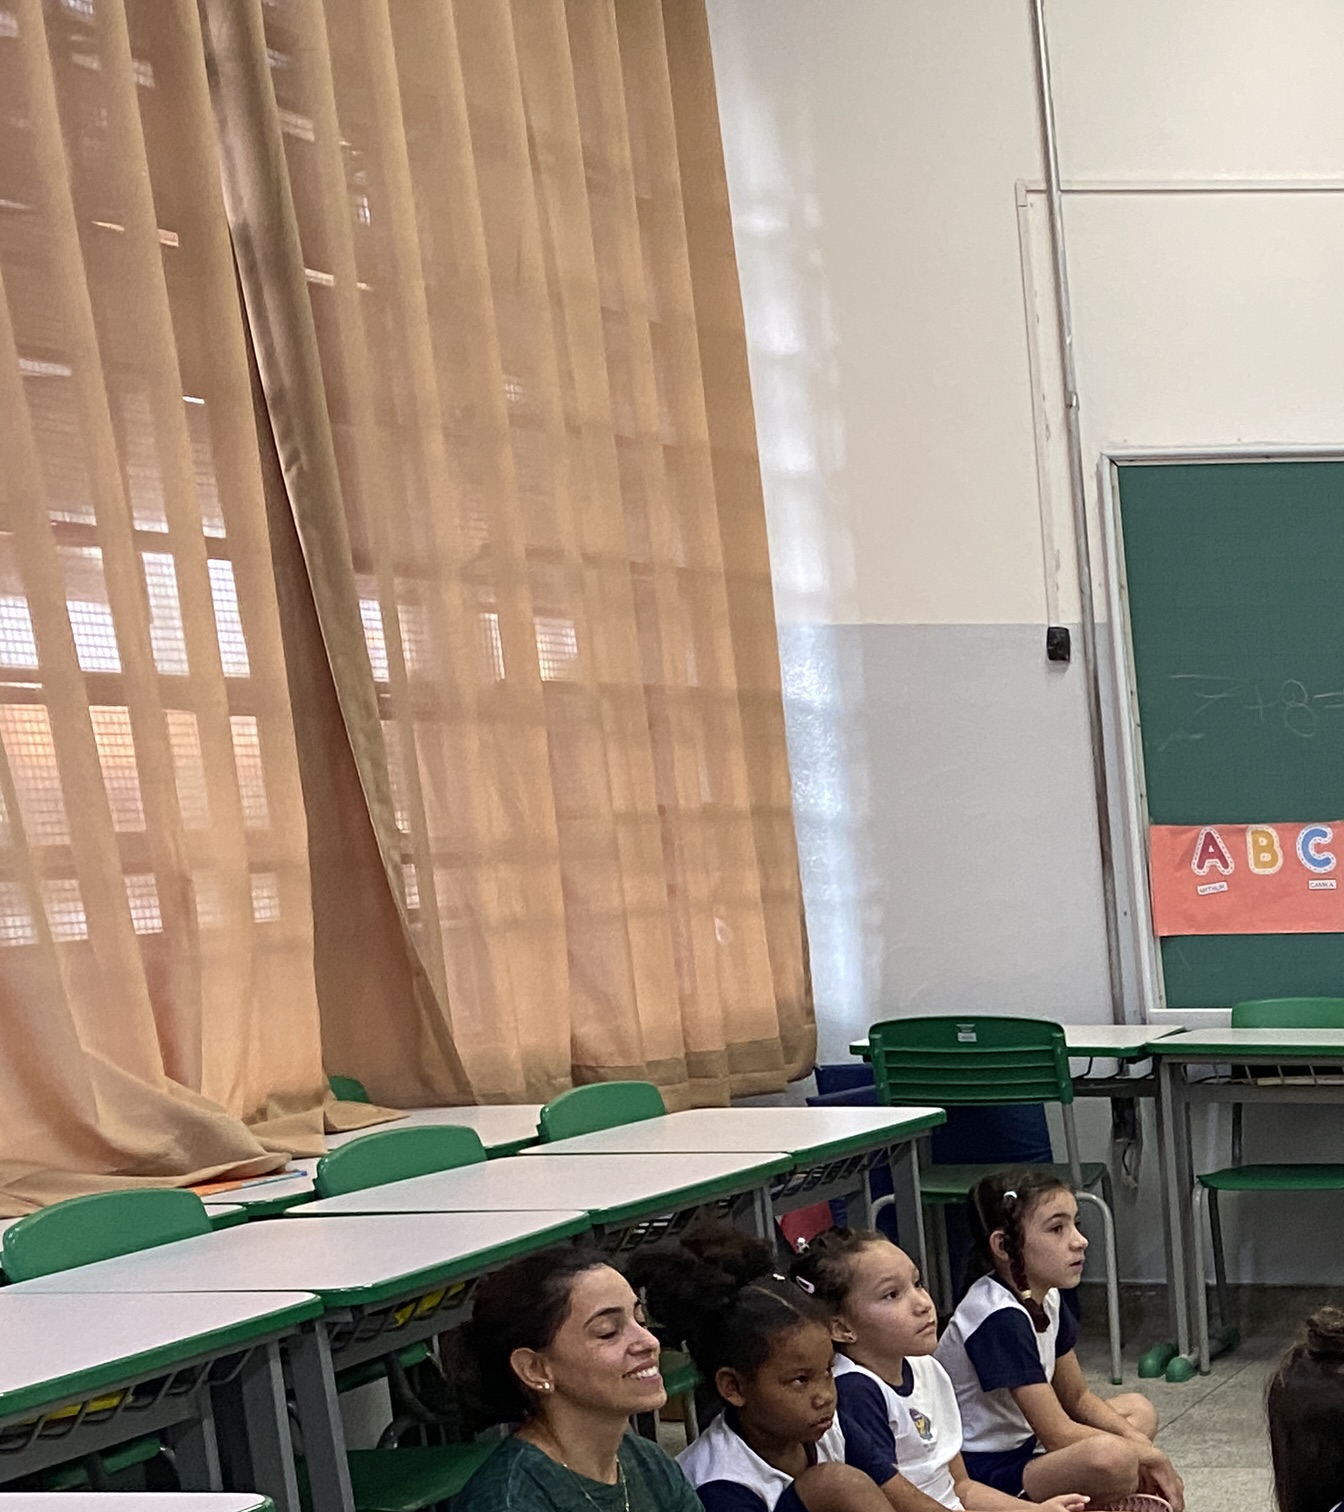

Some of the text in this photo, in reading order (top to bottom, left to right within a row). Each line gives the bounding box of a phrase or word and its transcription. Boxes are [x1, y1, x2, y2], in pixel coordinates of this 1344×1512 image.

[1194, 828, 1232, 872] A
[1248, 827, 1280, 872] B
[1299, 826, 1334, 870] C
